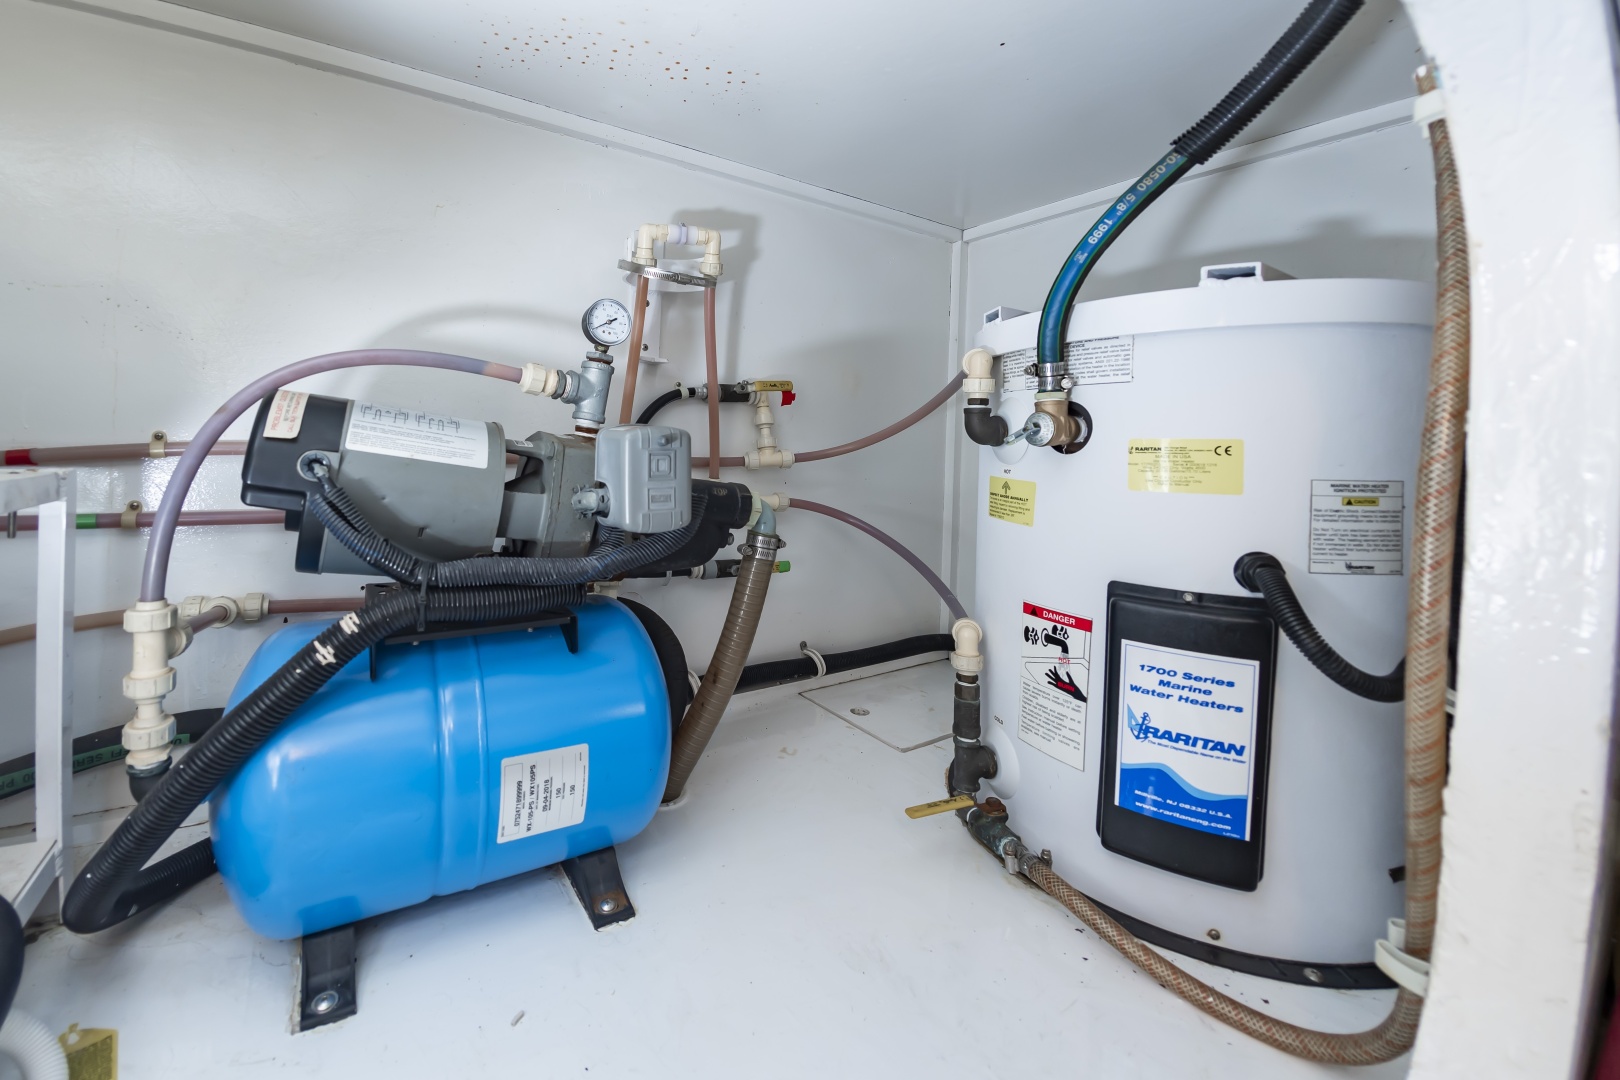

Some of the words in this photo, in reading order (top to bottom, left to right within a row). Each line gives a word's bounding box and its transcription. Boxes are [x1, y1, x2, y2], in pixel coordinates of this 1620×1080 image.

[1116, 193, 1136, 216] 5/8"
[1088, 218, 1112, 244] 1999
[1043, 611, 1076, 625] DANGER
[1139, 664, 1178, 678] 1700
[1182, 672, 1235, 688] Series
[1058, 681, 1075, 692] BURN
[1158, 680, 1212, 696] Marine
[1130, 684, 1173, 700] Water
[1178, 694, 1244, 713] Heaters
[1144, 726, 1245, 756] RARITAN
[1170, 744, 1198, 755] Dependable
[73, 753, 103, 769] SERI
[1135, 801, 1231, 831] www.raritaneng.com
[1179, 803, 1207, 813] 08332
[1209, 810, 1232, 819] U.S.A.
